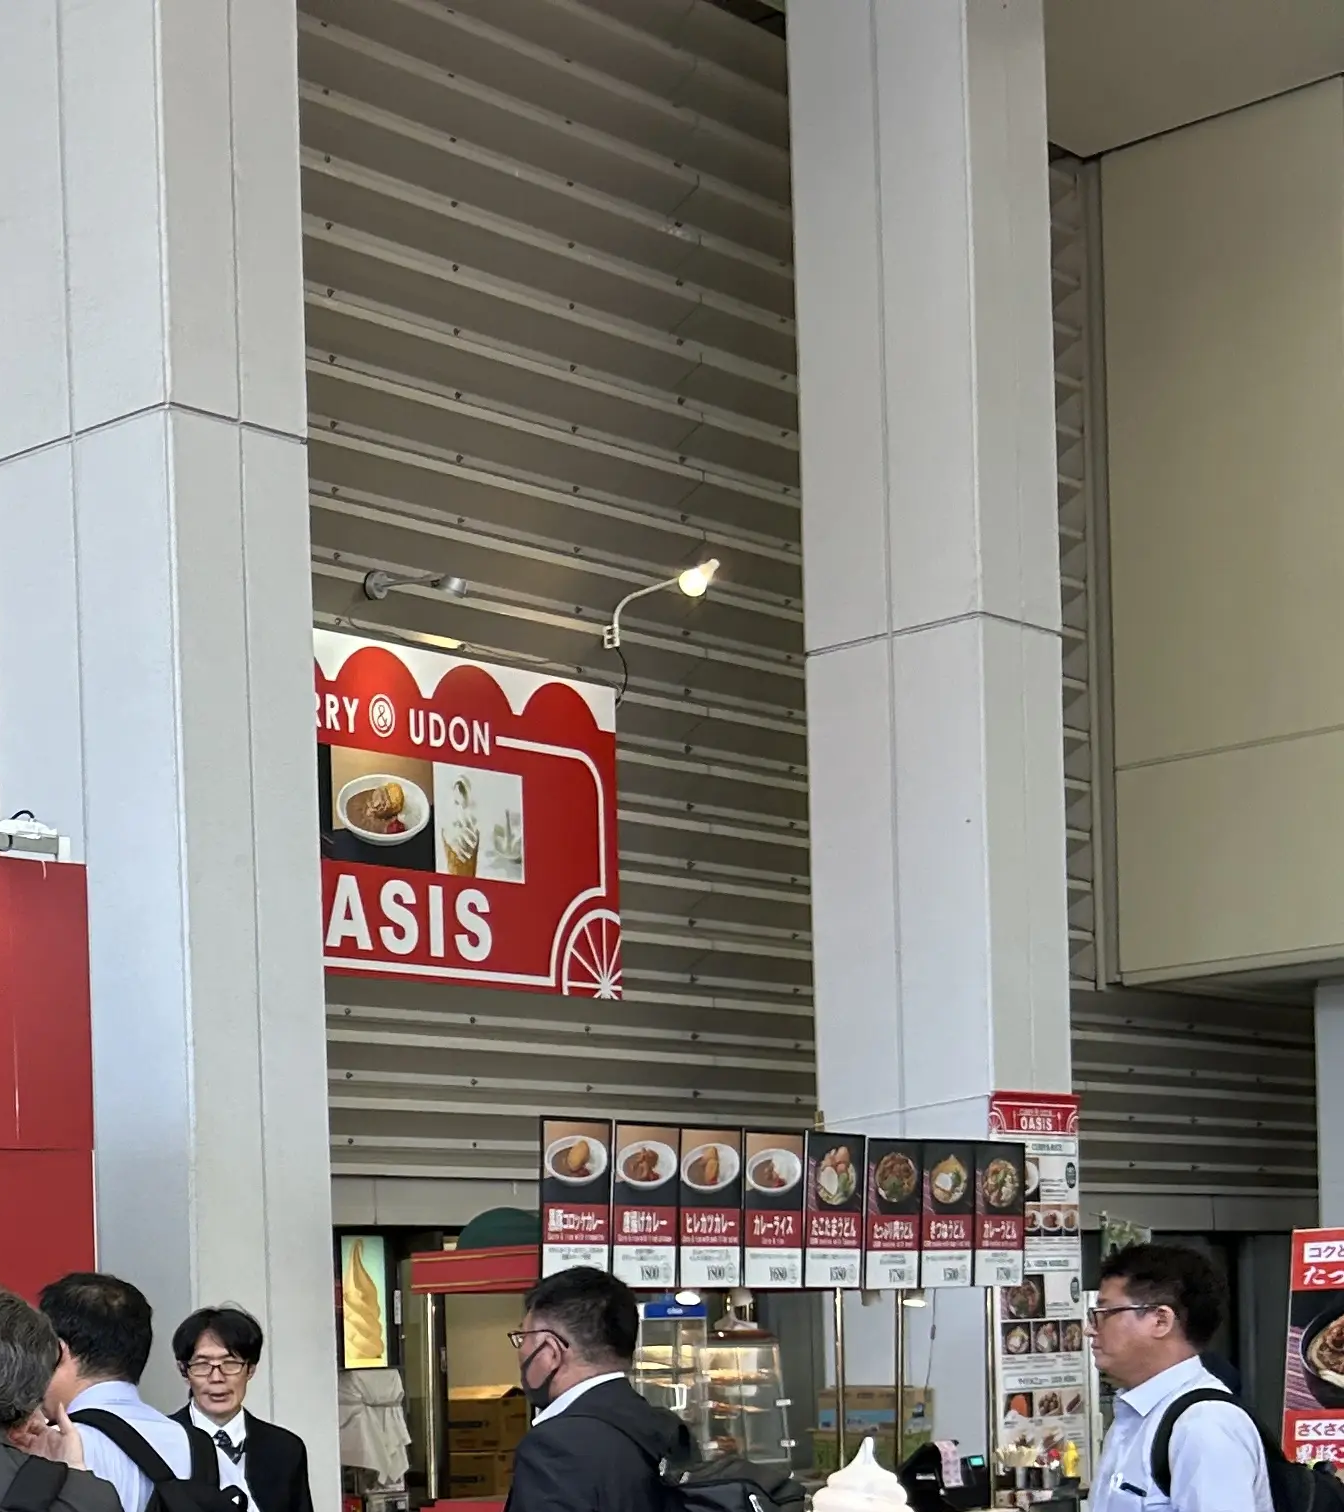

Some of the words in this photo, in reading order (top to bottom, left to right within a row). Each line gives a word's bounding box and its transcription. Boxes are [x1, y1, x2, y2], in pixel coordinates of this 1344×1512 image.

[409, 708, 491, 755] UDON
[326, 874, 493, 962] ASIS
[1020, 1116, 1052, 1131] OASIS
[753, 1215, 793, 1236] カレーライス
